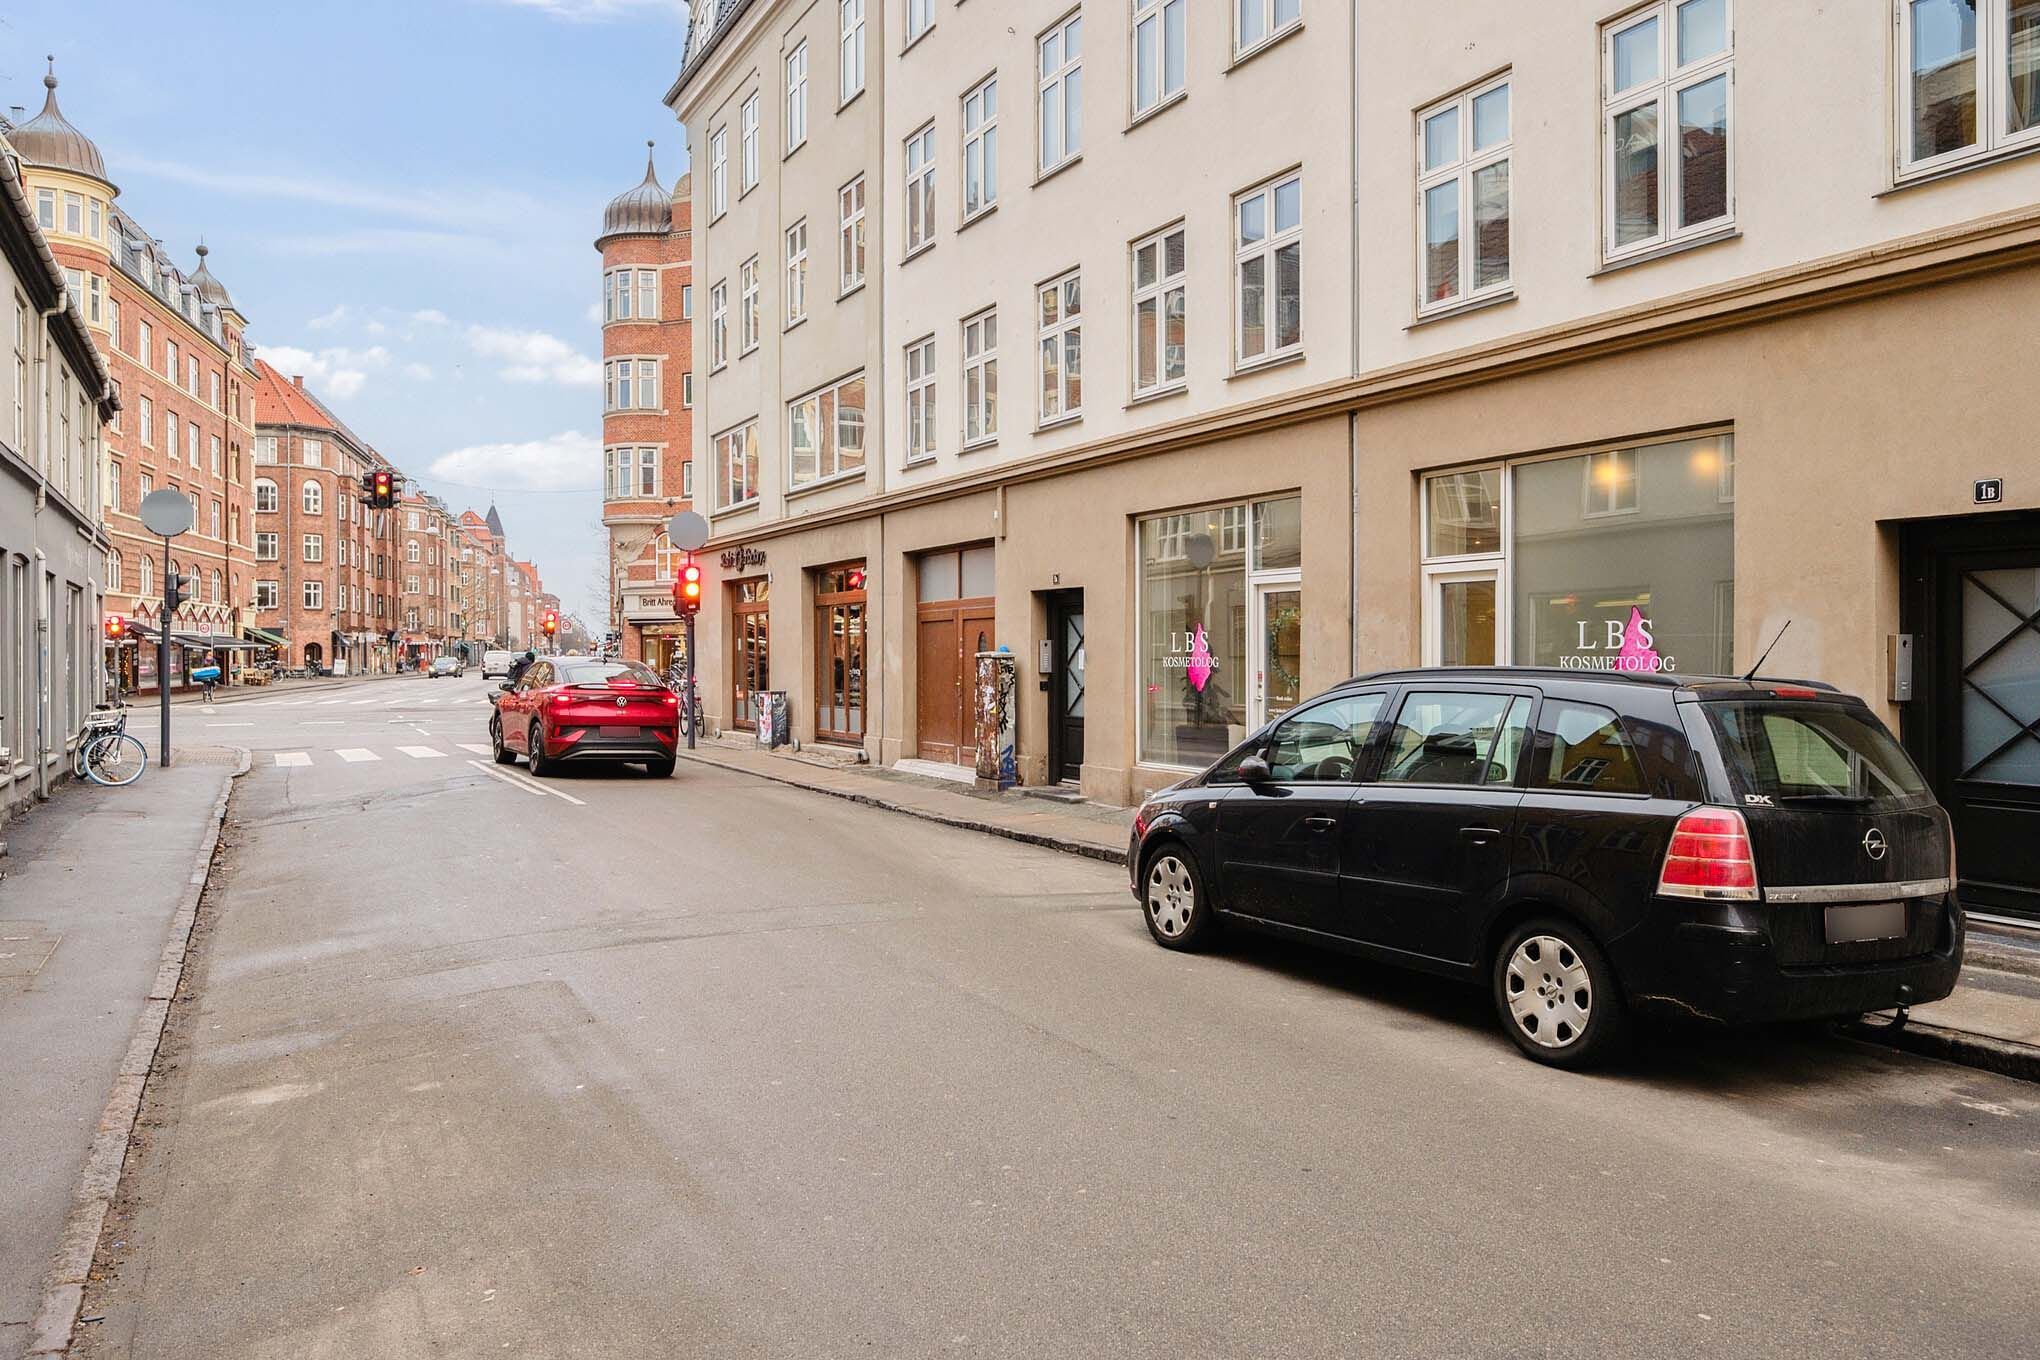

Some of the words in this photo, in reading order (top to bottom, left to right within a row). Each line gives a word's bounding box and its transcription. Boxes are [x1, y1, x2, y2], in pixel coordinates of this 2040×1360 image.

[1981, 484, 1995, 499] 1B
[642, 598, 656, 607] Britt
[1162, 656, 1220, 668] KOSMETOLOG
[1559, 655, 1676, 672] KOSMETOLOG
[1744, 794, 1773, 804] DK
